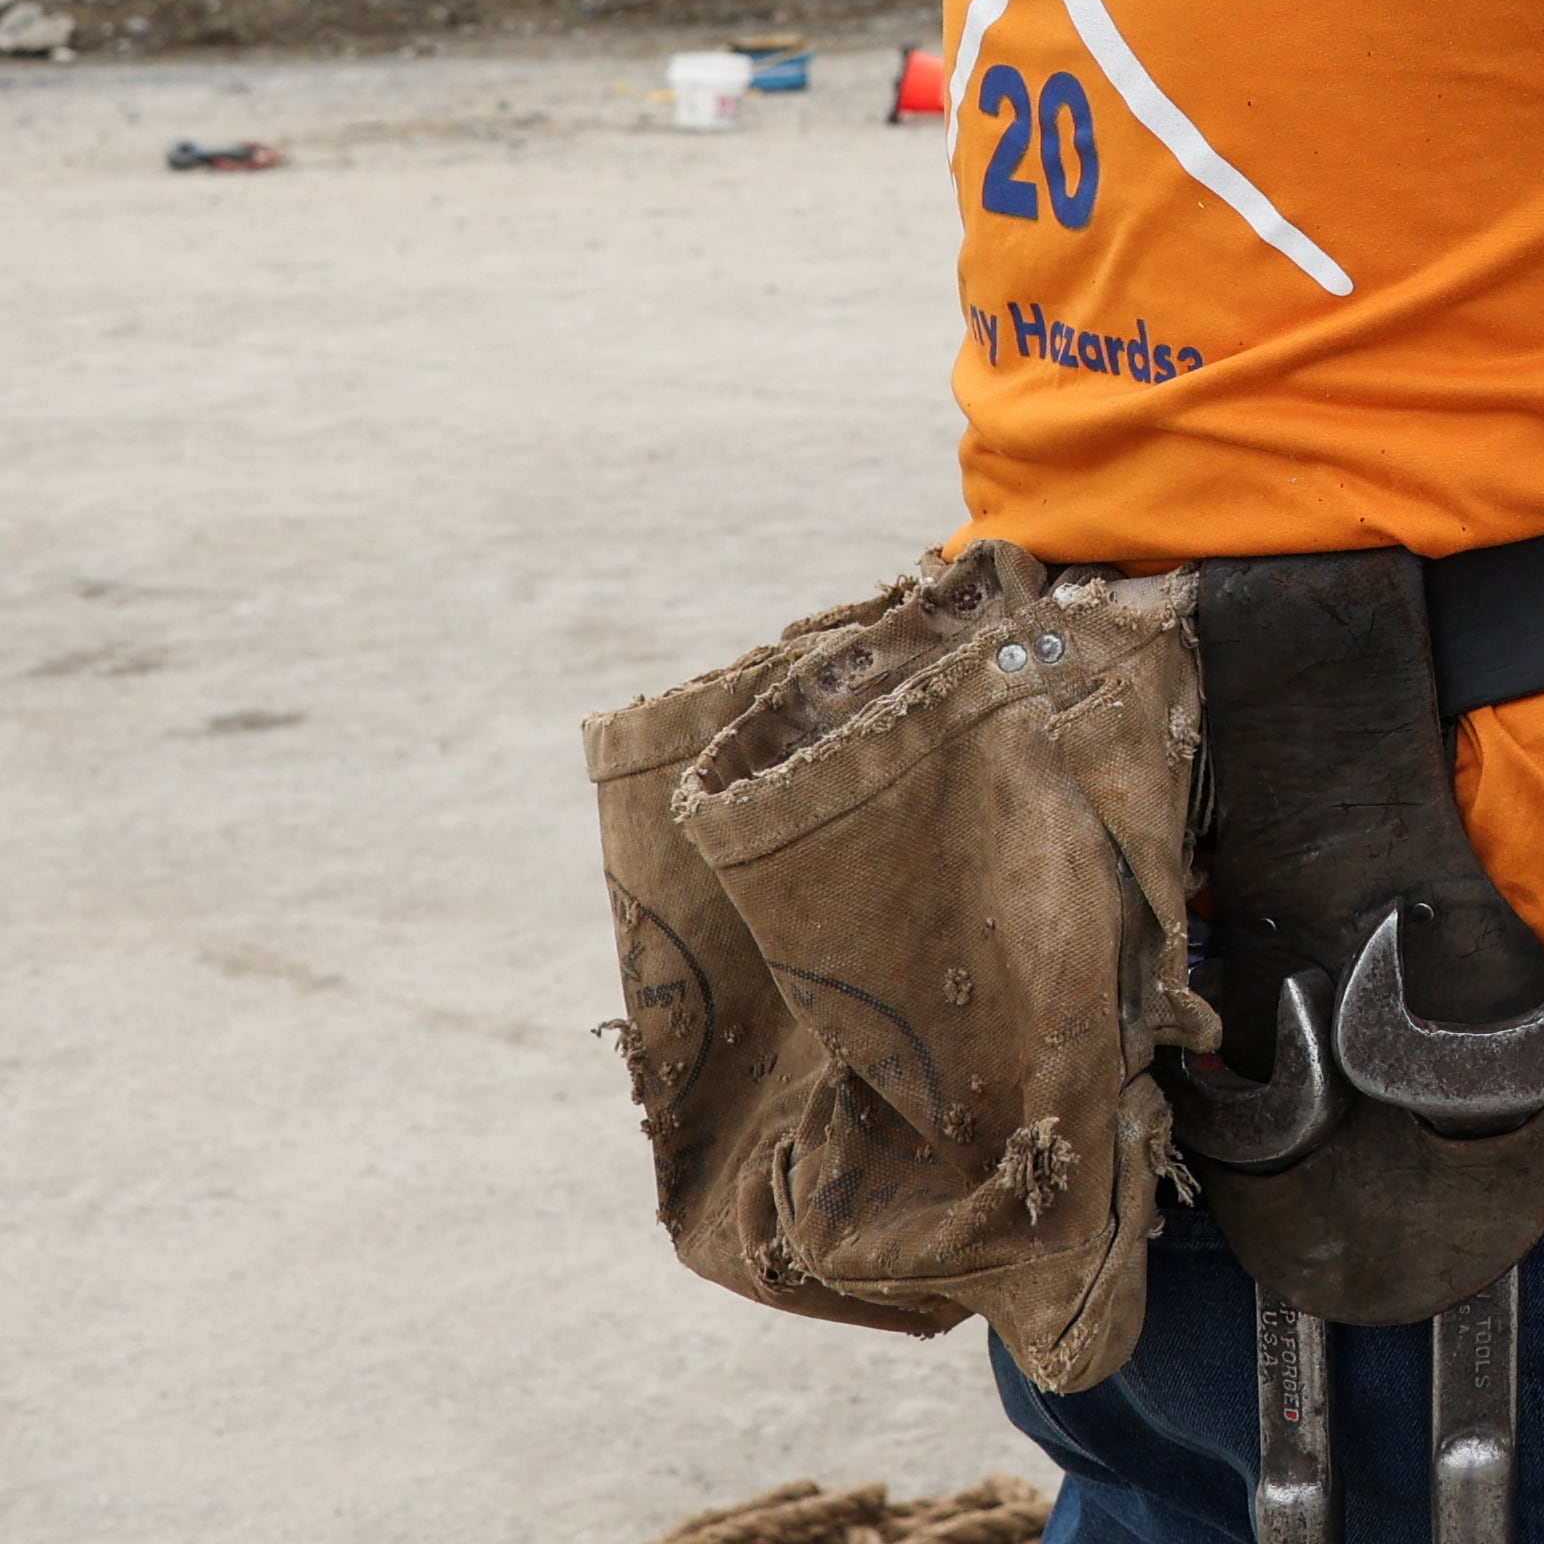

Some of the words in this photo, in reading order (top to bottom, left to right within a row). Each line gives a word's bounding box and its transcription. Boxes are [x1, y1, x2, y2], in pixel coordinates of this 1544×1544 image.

[978, 64, 1101, 231] 20
[969, 303, 998, 368] ny
[1281, 1336, 1300, 1422] FORGED
[1474, 1316, 1492, 1389] TOOLS
